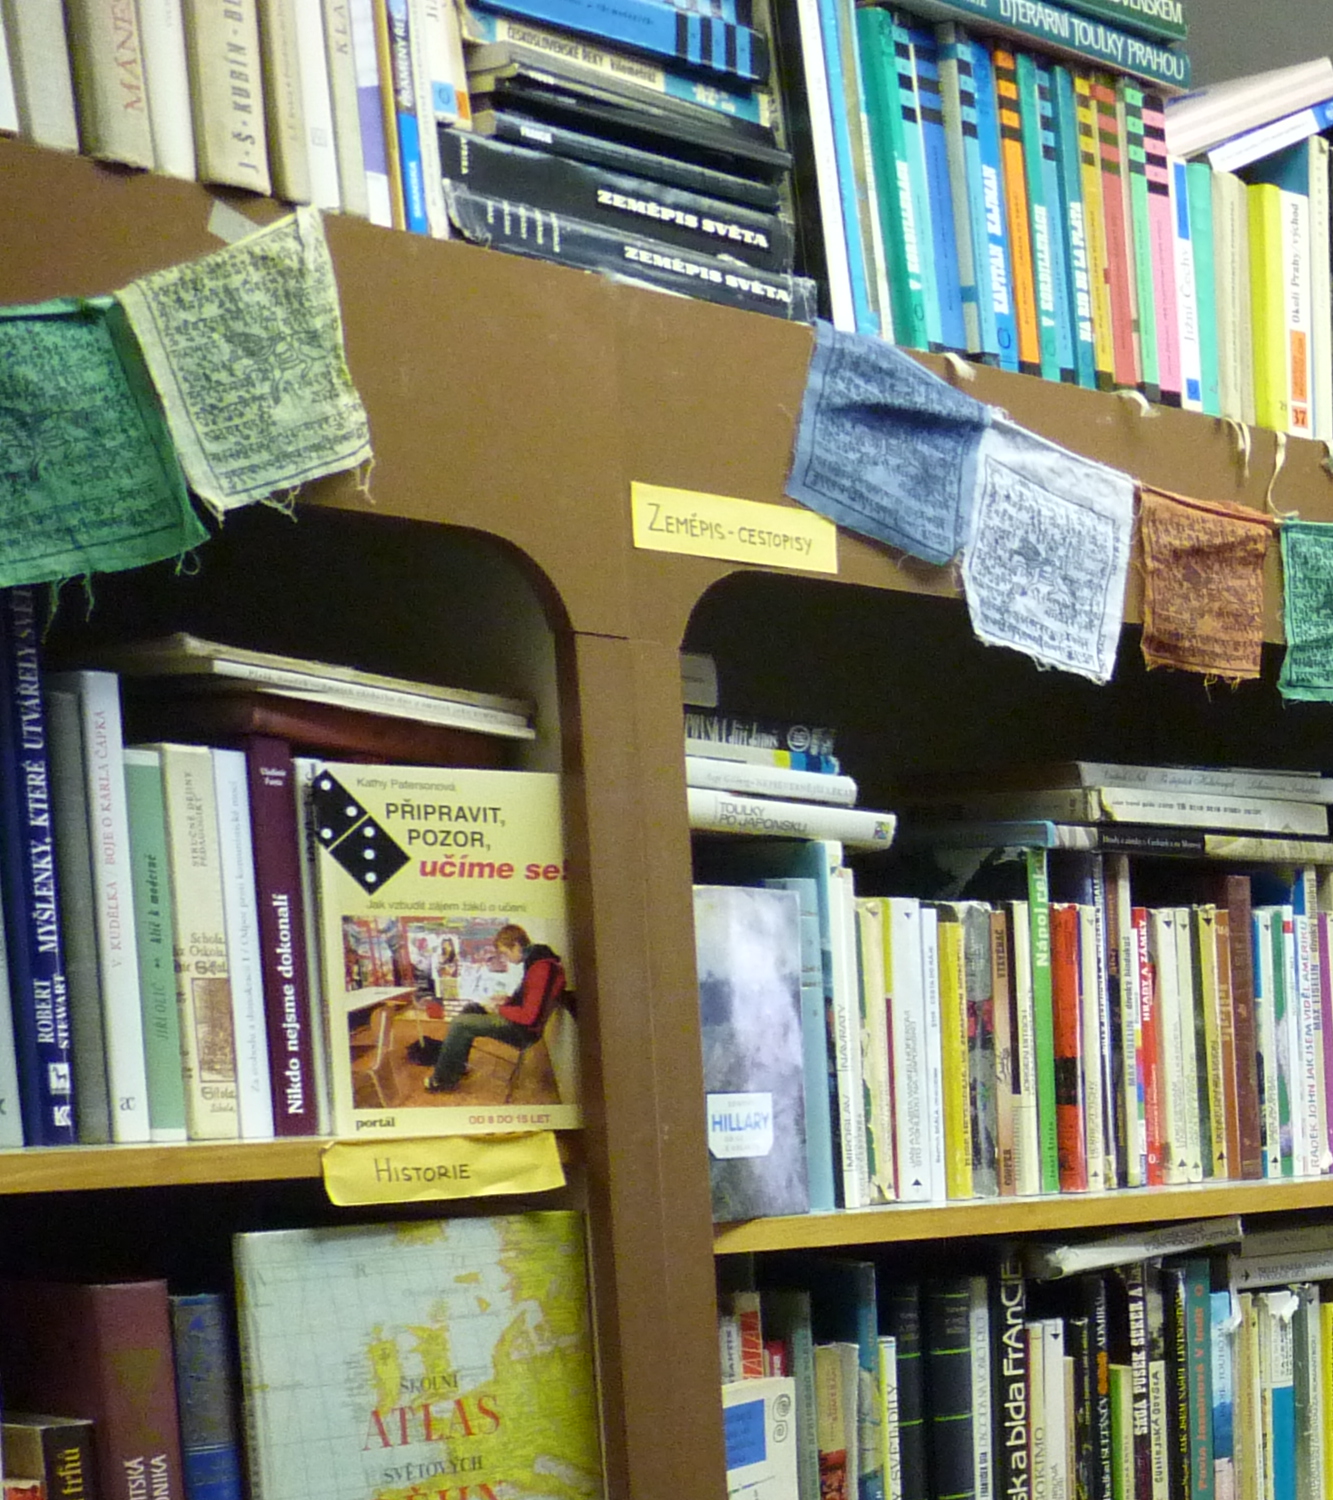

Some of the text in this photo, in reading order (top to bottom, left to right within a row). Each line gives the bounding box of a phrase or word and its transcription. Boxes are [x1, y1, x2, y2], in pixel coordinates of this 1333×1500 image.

[1070, 18, 1124, 62] TOULKY
[1127, 39, 1185, 80] PRAHOU
[596, 188, 770, 249] ZEMĚPIS SVĚTA
[623, 244, 793, 304] ZEMĚPIS SVĚTA
[1292, 407, 1308, 427] 37
[737, 526, 813, 556] CESTOPISY
[91, 708, 109, 760] ČAPKA
[16, 644, 61, 954] MYŠLENKY, KTERÉ UTVÁŘELY
[96, 764, 113, 812] KARLA
[356, 777, 388, 791] Kathy
[385, 798, 507, 827] PŘIPRAVIT,
[719, 801, 765, 816] TOULKY
[719, 814, 737, 826] PO
[102, 829, 117, 866] BOJE
[406, 828, 492, 852] POZOR,
[419, 854, 515, 880] učíme
[1033, 909, 1051, 968] Nápoj
[34, 978, 55, 1043] ROBERT
[53, 973, 71, 1050] STEWART
[271, 893, 304, 1115] Nikdo nejsme dokonalí
[1306, 1084, 1318, 1119] JOHN
[355, 1116, 396, 1132] portál
[530, 1113, 552, 1124] LET
[710, 1112, 769, 1133] HILLARY
[373, 1157, 472, 1183] HISTORIE
[1128, 1286, 1147, 1394] PUSEK SEKER A
[361, 1395, 502, 1452] ATLAS
[382, 1454, 484, 1486] SVĚTOVÝCH
[1010, 1451, 1027, 1470] a
